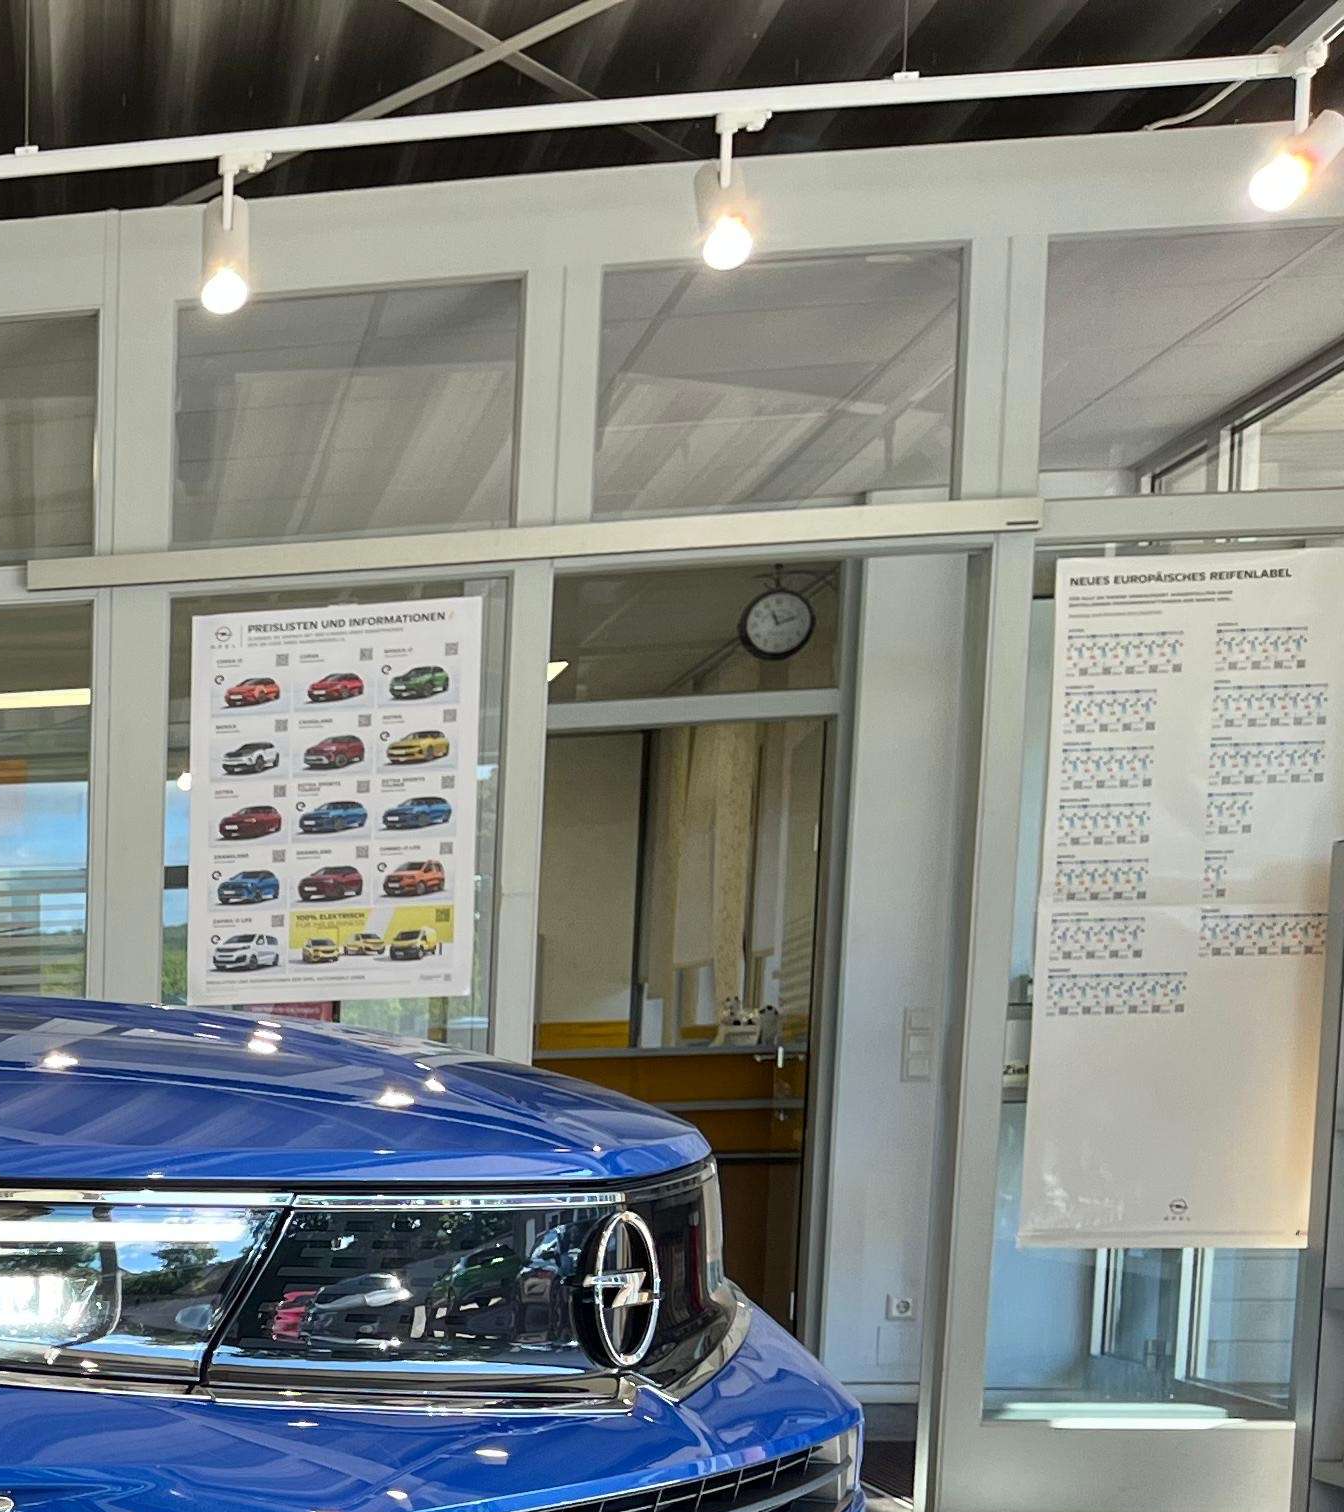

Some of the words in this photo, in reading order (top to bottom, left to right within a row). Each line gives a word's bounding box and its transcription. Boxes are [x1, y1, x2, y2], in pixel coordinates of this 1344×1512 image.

[1069, 575, 1110, 587] NEUES
[1113, 571, 1206, 585] EUROPÄISCHES
[1209, 568, 1293, 581] REIFENLABEL
[247, 621, 318, 633] PREISLISTEN
[321, 618, 346, 629] UND
[348, 611, 446, 627] INFORMATIONEN
